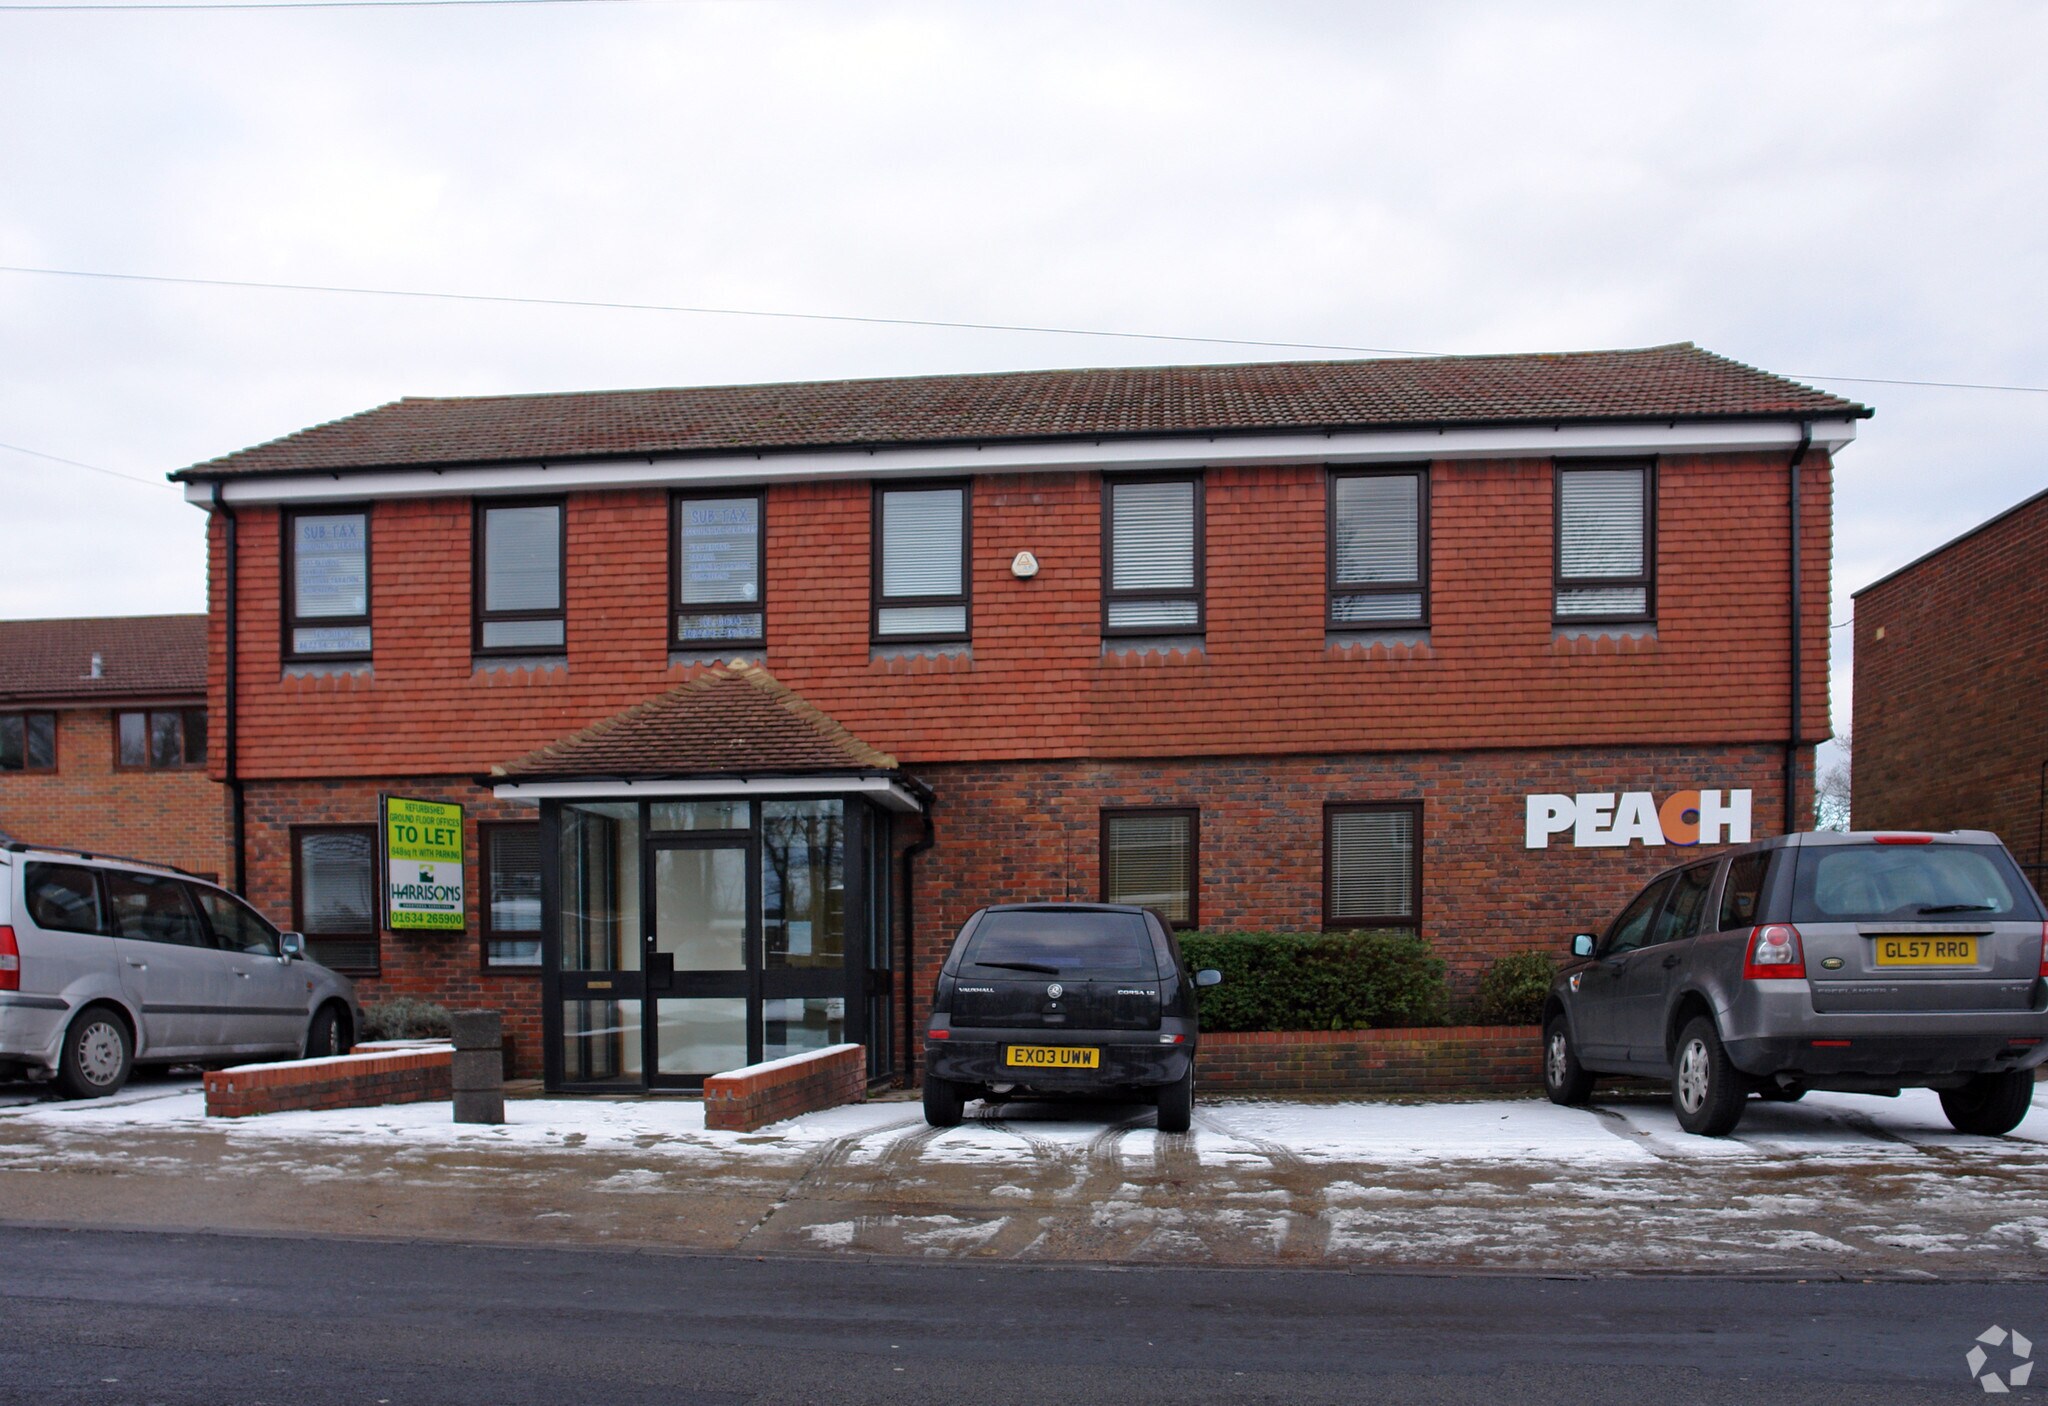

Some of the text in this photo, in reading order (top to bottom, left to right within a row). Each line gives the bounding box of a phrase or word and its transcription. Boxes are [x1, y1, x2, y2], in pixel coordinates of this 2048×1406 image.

[692, 507, 748, 524] SUB TAX
[304, 523, 357, 539] SUB TAX
[405, 803, 445, 815] REFURBISHED
[390, 813, 459, 827] GROUND FLOOR OFFICES
[1525, 789, 1753, 849] PEACH
[394, 825, 456, 846] TO LET
[419, 849, 435, 858] WITH
[436, 850, 460, 859] PARKING
[391, 883, 461, 902] HARRISONS
[392, 912, 462, 924] 01634 265900
[1885, 942, 1969, 957] GL57 RRO
[1015, 1049, 1092, 1064] EX03 UWW
